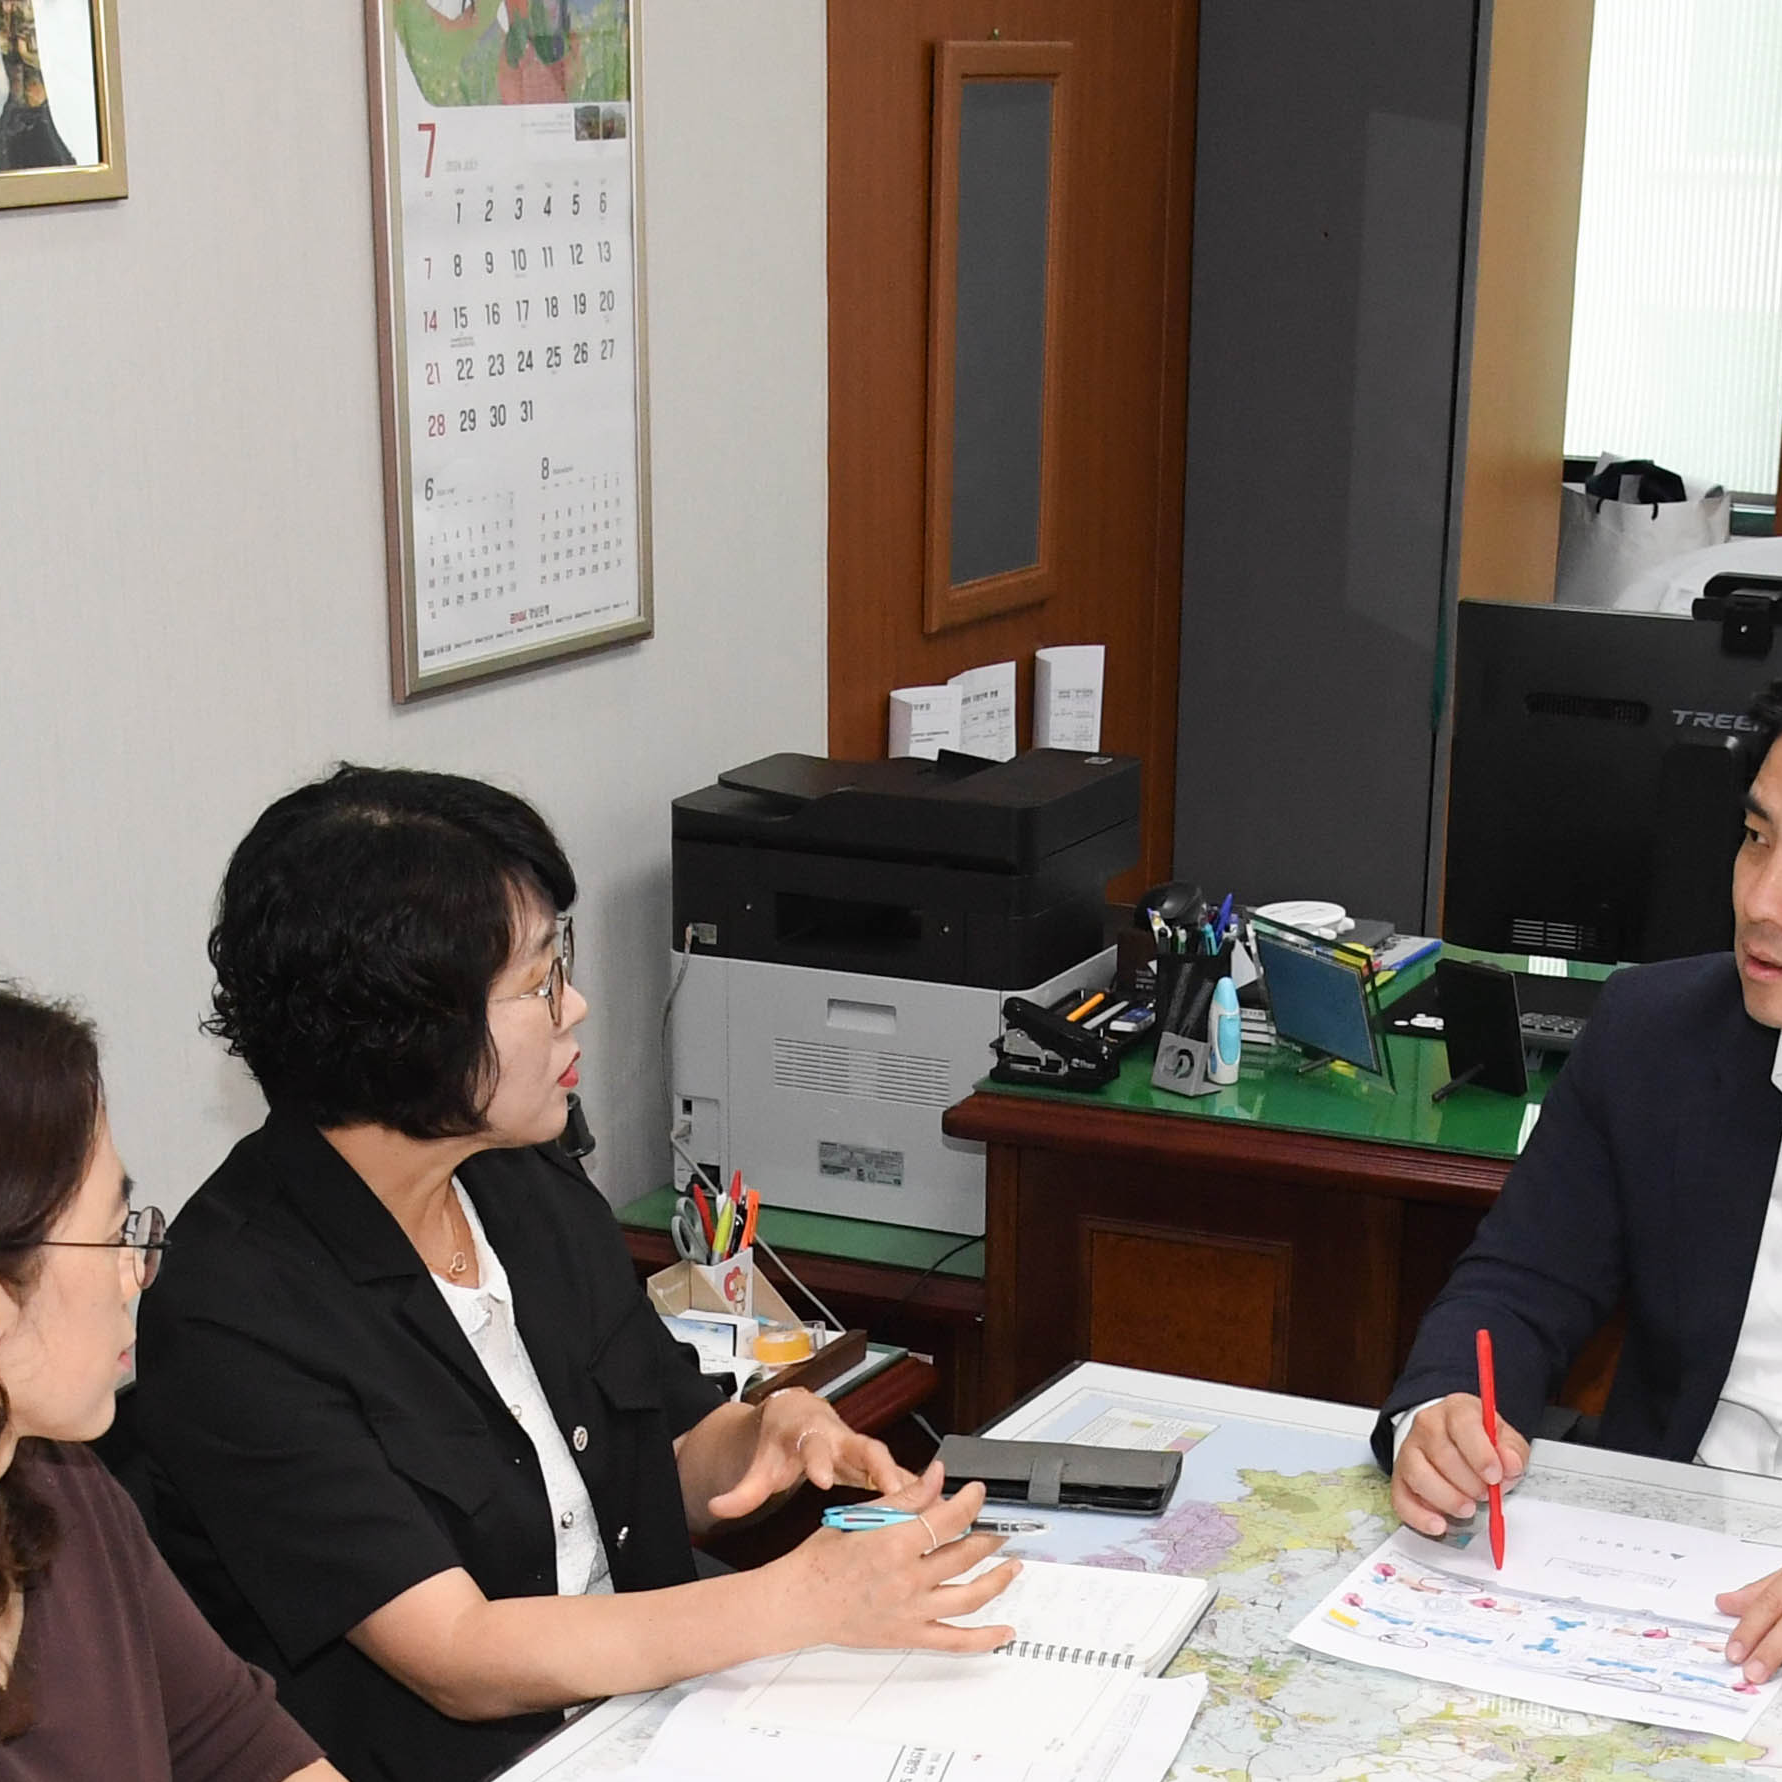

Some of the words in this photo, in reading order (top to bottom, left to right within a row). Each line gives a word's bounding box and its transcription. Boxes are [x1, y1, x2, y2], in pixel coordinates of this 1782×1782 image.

[417, 122, 437, 179] 7
[456, 201, 462, 225] 1
[484, 199, 494, 223] 2
[514, 197, 524, 221] 3
[543, 195, 552, 217] 4
[571, 193, 581, 216] 5
[599, 191, 608, 214] 6
[424, 256, 432, 281] 7
[453, 253, 463, 278] 8
[484, 251, 494, 275] 9
[510, 247, 528, 271] 10
[541, 245, 554, 269] 11
[568, 242, 584, 266] 12
[597, 240, 612, 263] 13
[422, 309, 438, 333] 14
[452, 305, 469, 329] 15
[484, 302, 501, 326] 16
[515, 299, 530, 322] 17
[544, 295, 559, 319] 18
[572, 292, 587, 315] 19
[599, 289, 615, 313] 20
[424, 361, 441, 386] 21
[456, 357, 475, 382] 22
[487, 353, 505, 377] 23
[517, 349, 534, 373] 24
[545, 345, 562, 369] 25
[573, 341, 589, 365] 26
[600, 338, 615, 361] 27
[427, 413, 446, 438] 28
[459, 408, 477, 433] 29
[489, 403, 507, 428] 30
[520, 399, 534, 423] 31
[541, 456, 550, 481] 8
[424, 477, 434, 502] 6
